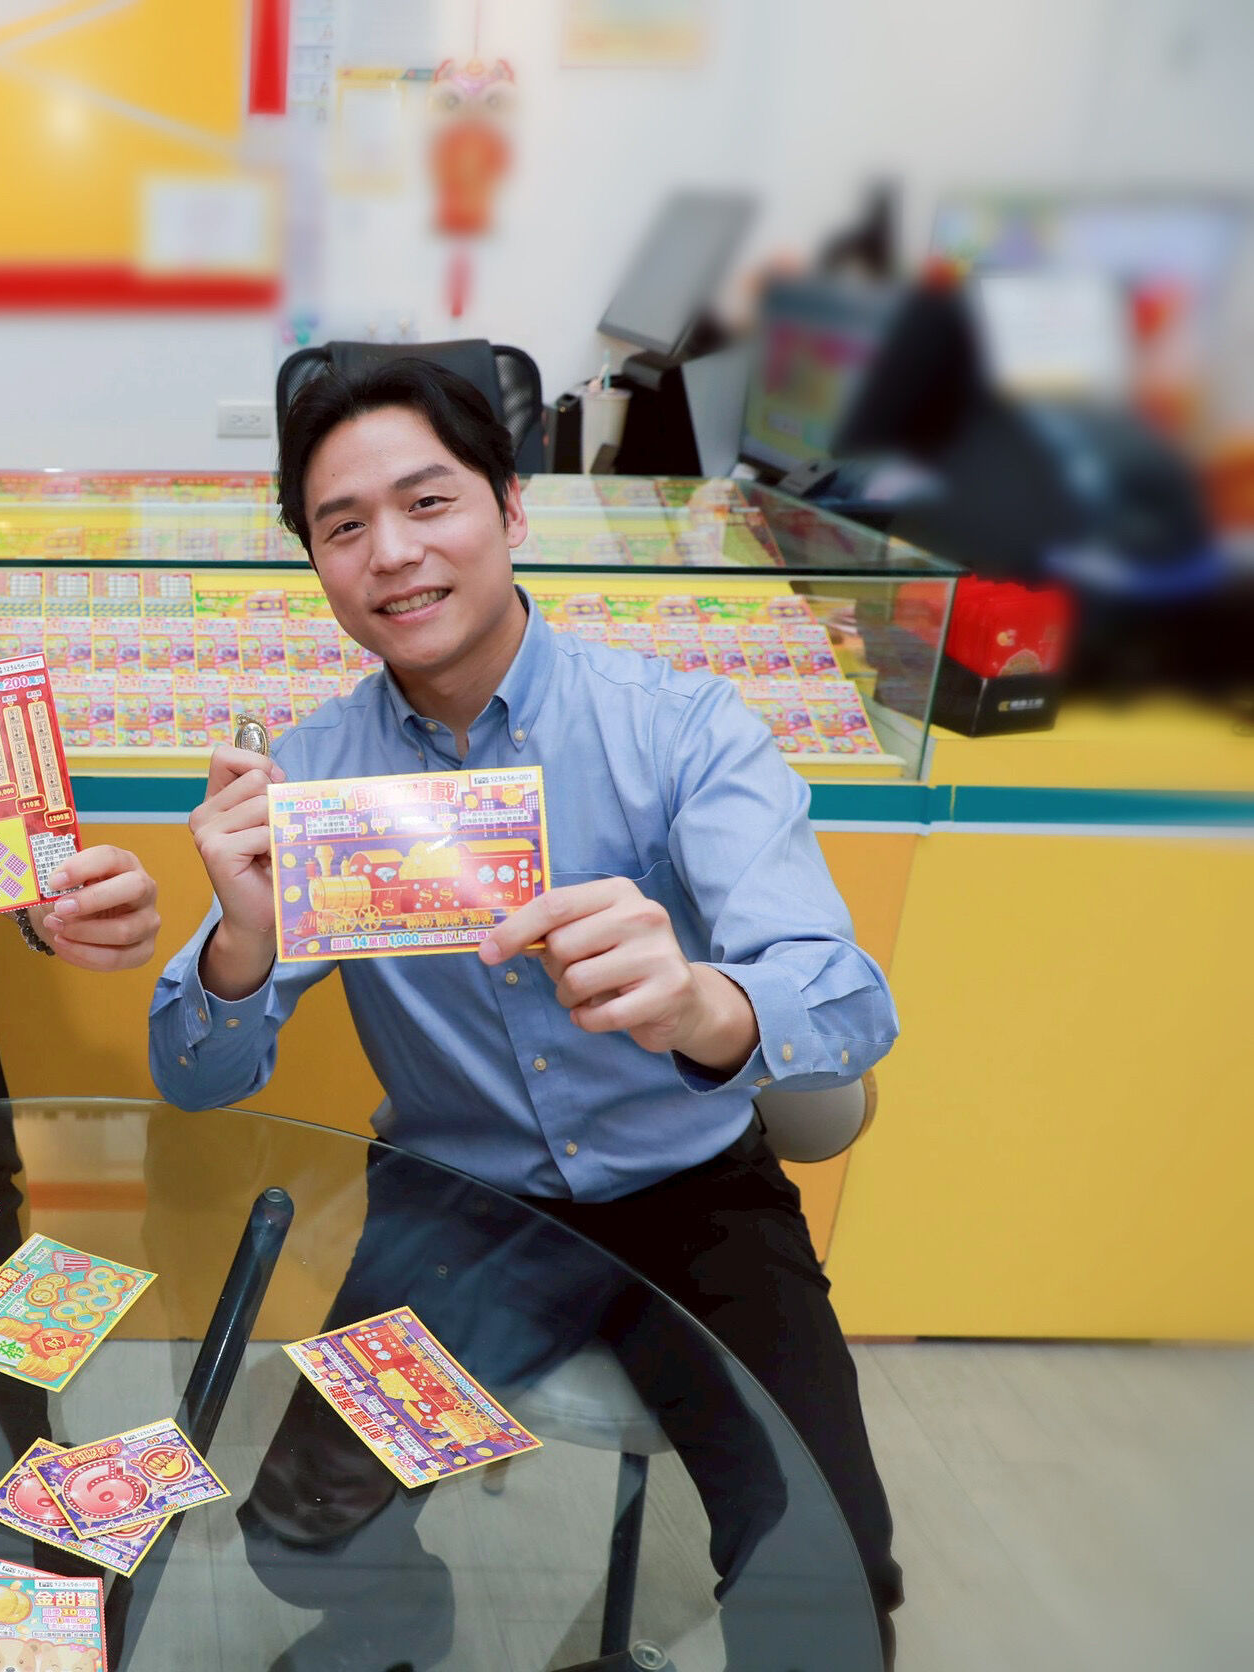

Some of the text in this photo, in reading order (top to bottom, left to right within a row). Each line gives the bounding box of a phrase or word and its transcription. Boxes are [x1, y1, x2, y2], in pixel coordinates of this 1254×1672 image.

[490, 773, 532, 784] 123456-001
[326, 1383, 390, 1441] 財富滿載
[35, 1591, 97, 1607] 金甜蜜
